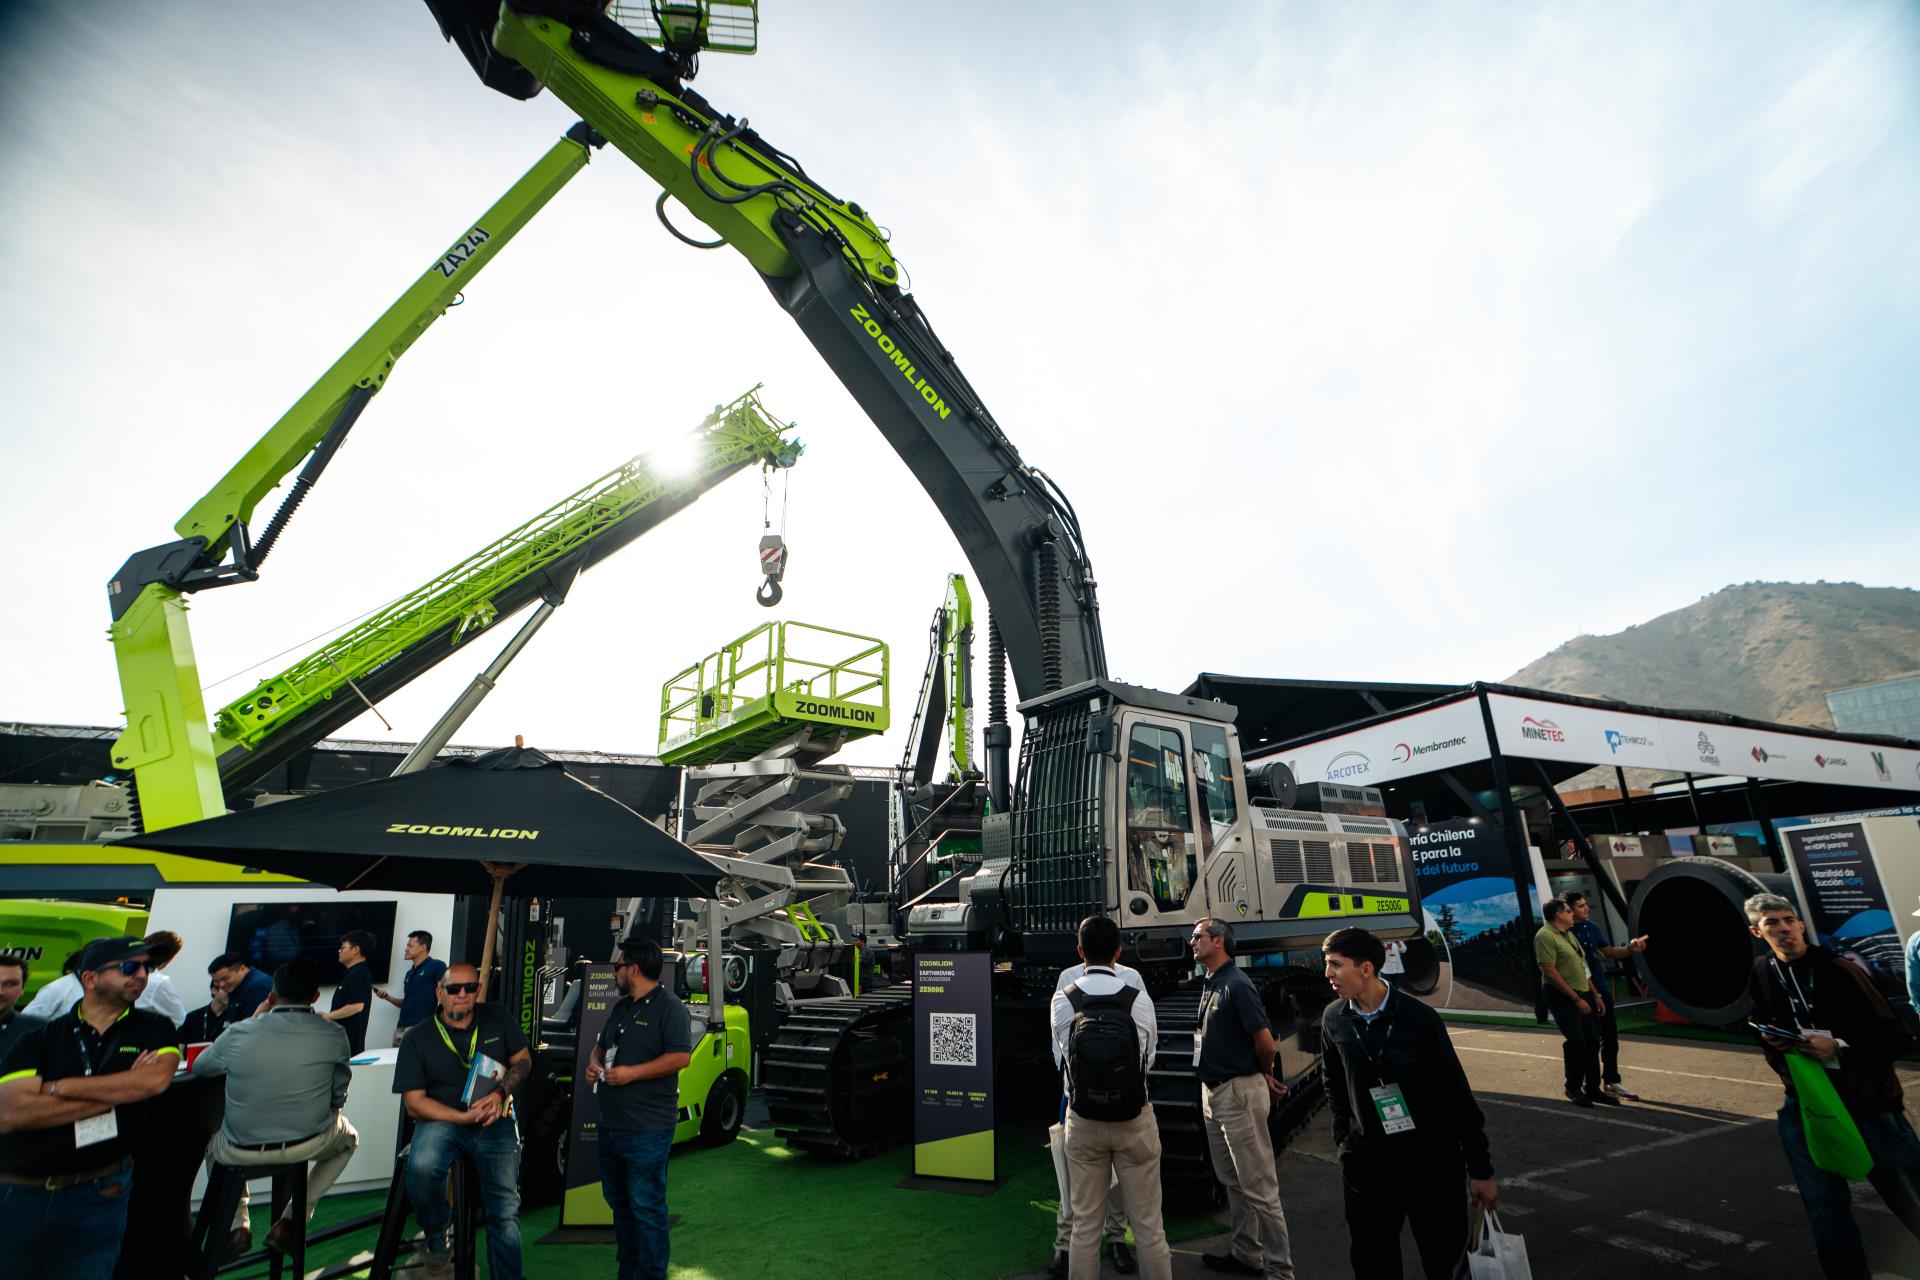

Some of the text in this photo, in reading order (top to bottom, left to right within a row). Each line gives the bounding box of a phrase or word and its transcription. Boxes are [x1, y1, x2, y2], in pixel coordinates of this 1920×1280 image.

[433, 226, 490, 278] ZA24J
[850, 303, 951, 420] ZOOMLION
[795, 700, 875, 723] ZOOMLION
[1521, 726, 1565, 743] MINETEC
[1412, 735, 1467, 756] Membrantec
[1327, 762, 1370, 781] ARCOTEX
[385, 823, 540, 840] ZOOMLION
[1429, 828, 1475, 843] Chilena
[1420, 848, 1448, 863] para
[1450, 846, 1461, 857] la
[1422, 863, 1440, 876] del
[1441, 861, 1479, 874] futuro
[1812, 868, 1855, 878] Manifold de
[1814, 878, 1844, 887] Succión
[1376, 900, 1402, 912] ZE500G
[520, 939, 536, 1036] ZOOMLION
